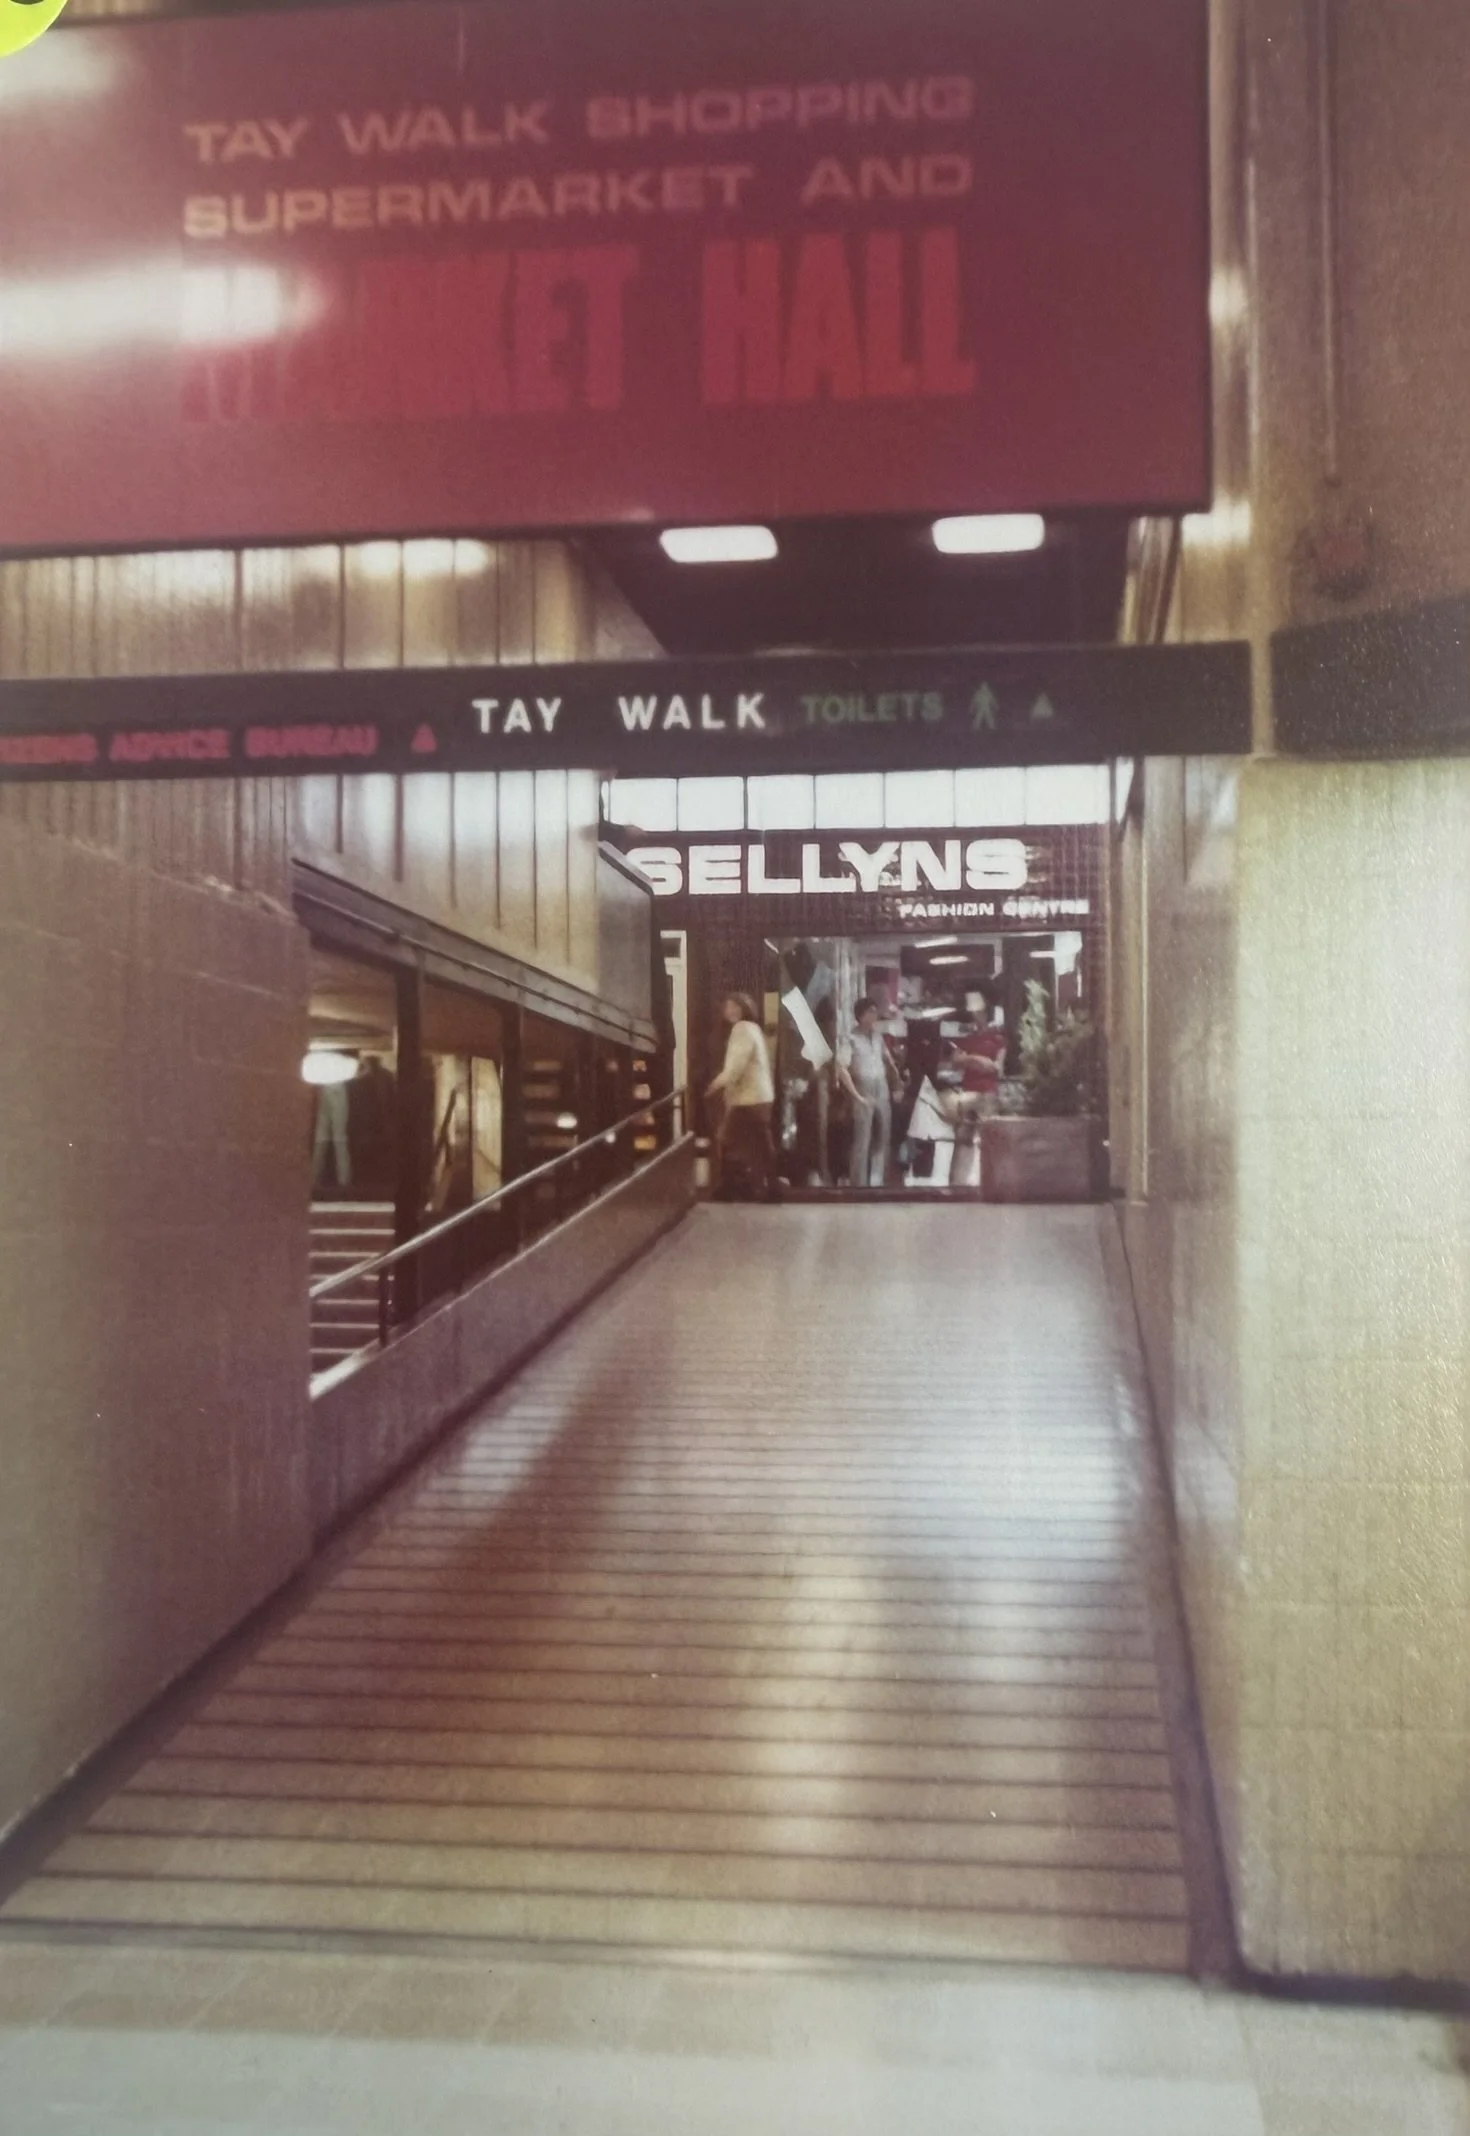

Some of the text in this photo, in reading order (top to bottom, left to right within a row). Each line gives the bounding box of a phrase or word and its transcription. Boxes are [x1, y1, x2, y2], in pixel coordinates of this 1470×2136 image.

[185, 76, 975, 163] TAY WALK SHOPPING
[183, 154, 973, 239] SUPERMARKET AND
[701, 226, 977, 406] HALL
[471, 692, 766, 733] TAY WALK
[802, 692, 944, 724] TOILETS
[627, 838, 1029, 896] SELLYNS
[897, 902, 995, 918] FASHION
